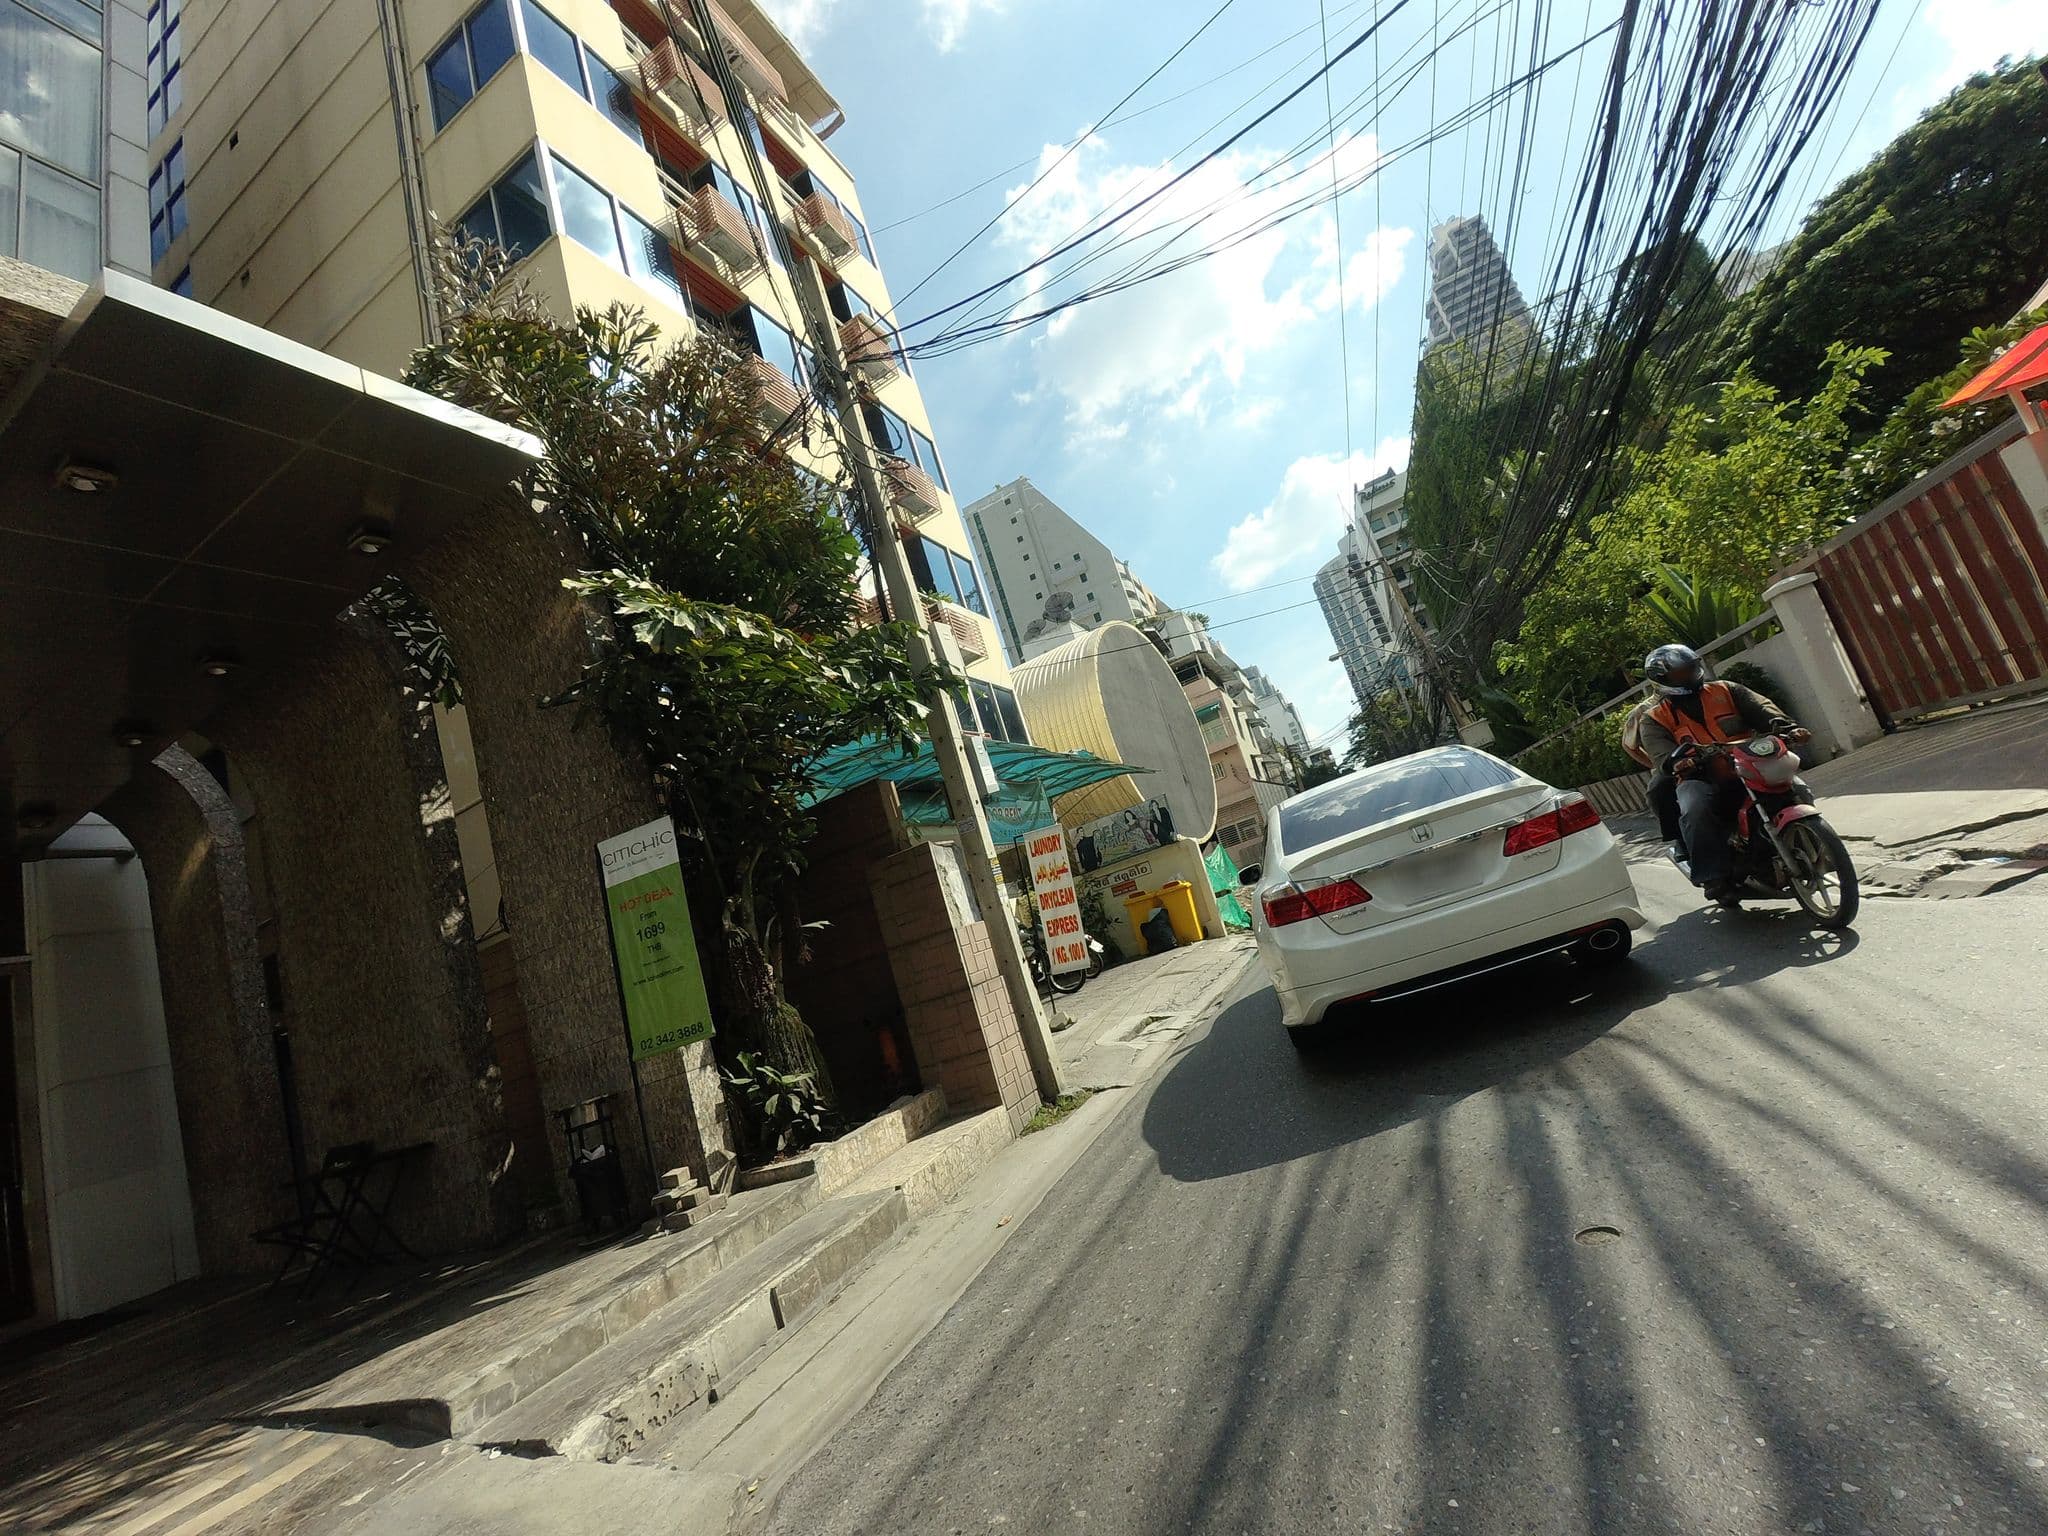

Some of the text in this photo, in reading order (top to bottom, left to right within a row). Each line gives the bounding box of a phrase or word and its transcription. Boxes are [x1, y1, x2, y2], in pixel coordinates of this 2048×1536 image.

[1029, 833, 1062, 858] LAUNDRY
[620, 886, 674, 913] HOT DEAL
[1039, 886, 1075, 911] DRYCLEAN
[639, 910, 657, 922] From
[1046, 914, 1079, 938] EXPRESS
[636, 921, 665, 942] 1699
[640, 1022, 704, 1050] 02 342 3888
